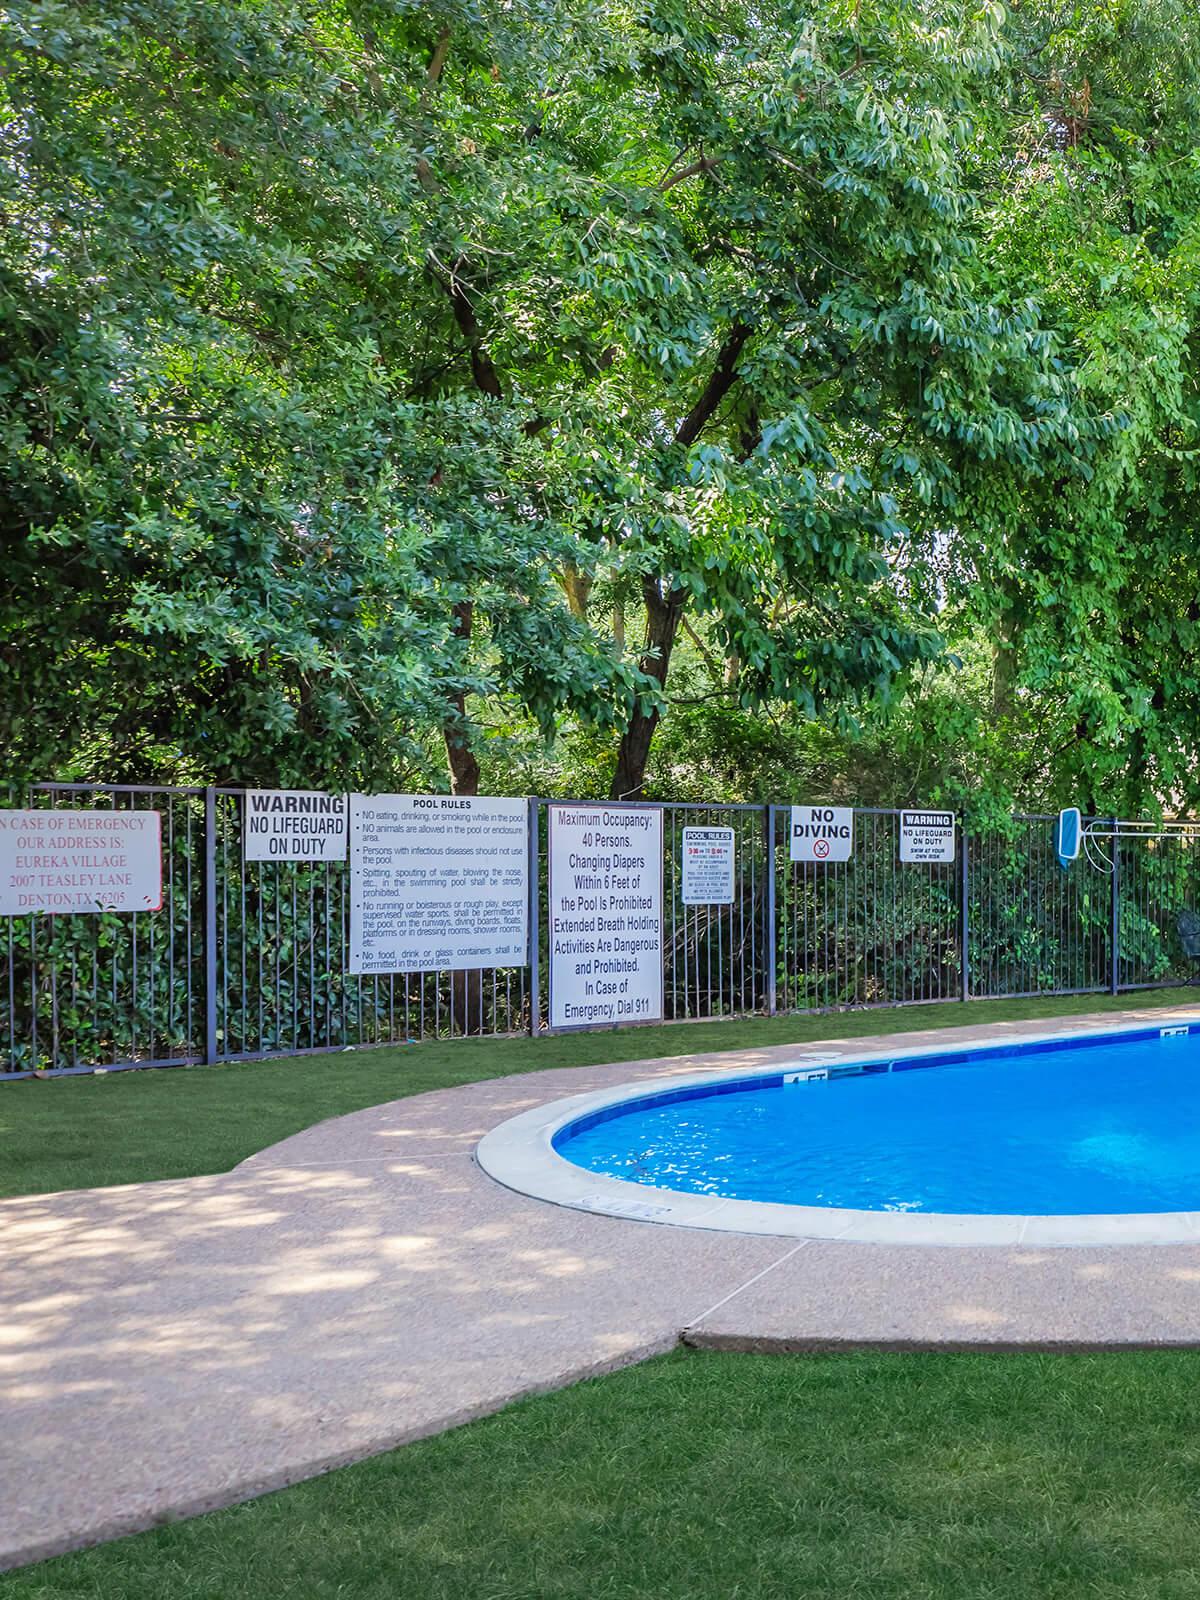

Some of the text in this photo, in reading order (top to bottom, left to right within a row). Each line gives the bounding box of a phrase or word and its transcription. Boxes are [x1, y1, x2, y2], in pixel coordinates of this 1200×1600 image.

[251, 796, 344, 814] WARNING
[413, 799, 472, 809] POOL RULES
[559, 810, 652, 831] Maximum Occupancy:
[811, 809, 834, 822] NO
[906, 815, 950, 825] WARNING
[0, 818, 146, 830] N CASE OF EMERGENCY
[250, 817, 344, 834] NO LIFEGUARD
[793, 825, 850, 838] DIVING
[17, 837, 125, 849] OUR ADDRESS IS:
[269, 838, 326, 855] ON DUTY
[582, 833, 632, 848] 40 Persons.
[16, 855, 127, 868] EUREKA VILLAGE
[569, 853, 645, 872] Changing Diapers
[9, 873, 132, 887] 2007 TEASLEY LANE
[574, 875, 641, 889] Within 6 Feet of
[95, 892, 125, 904] 76205
[561, 896, 652, 911] the Pool Is Prohibited
[554, 916, 659, 933] Extended Breath Holding
[555, 937, 659, 955] Activities Are Dangerous
[575, 957, 639, 975] and Prohibited.
[585, 978, 628, 995] In Case of
[565, 999, 649, 1020] Emergency, Dial 911
